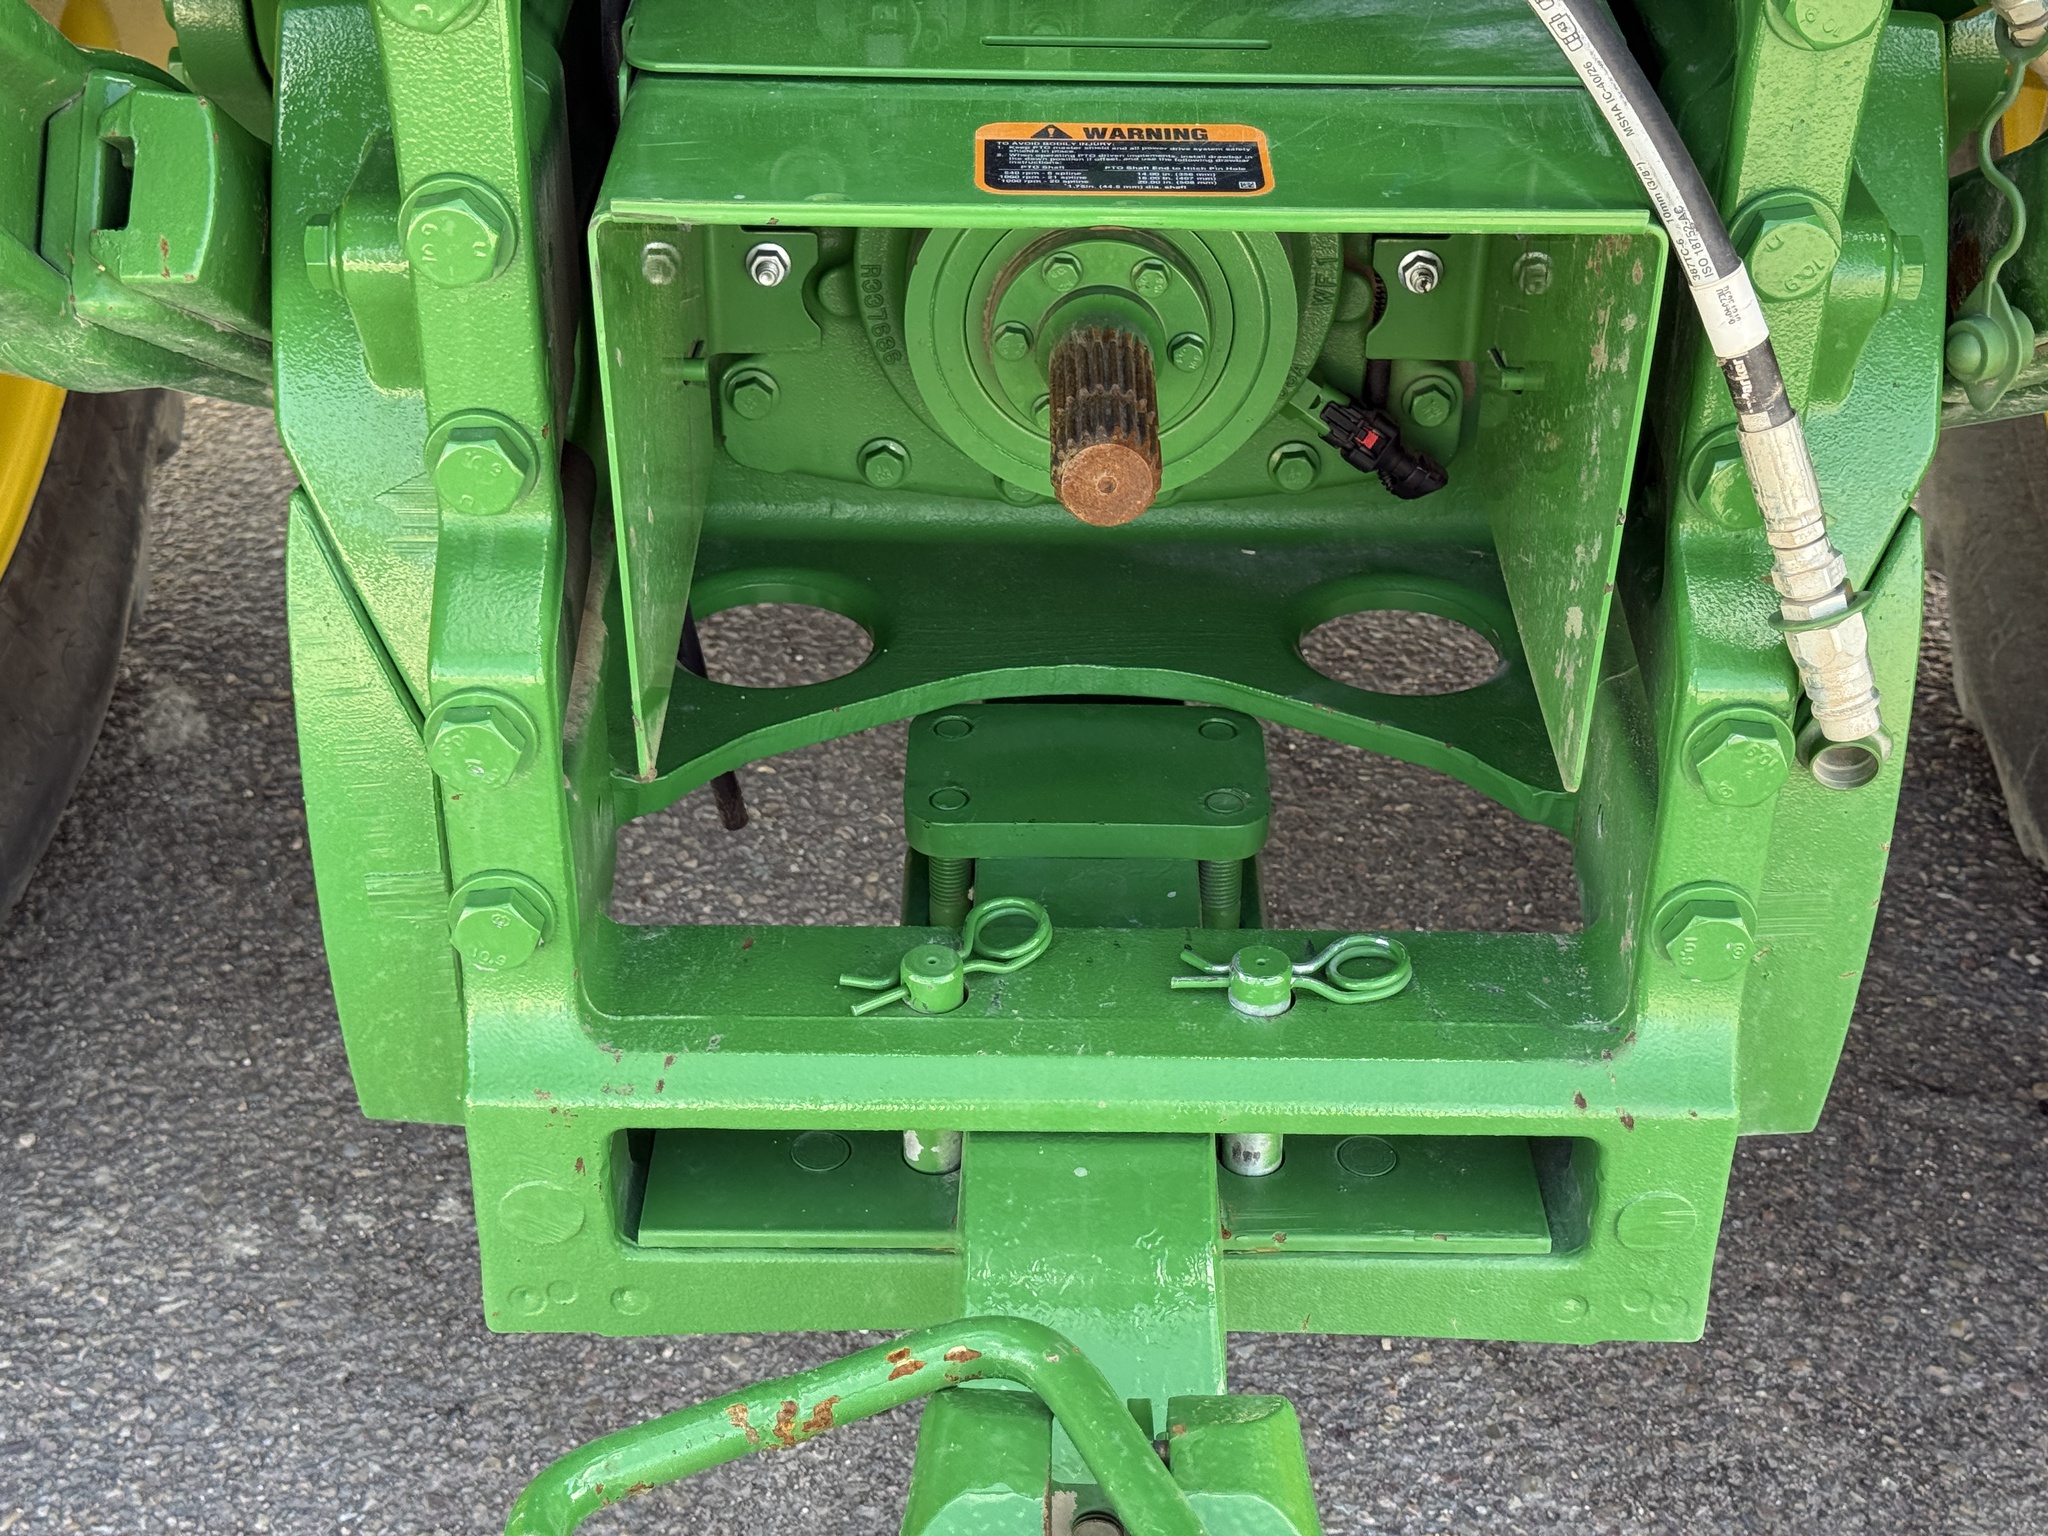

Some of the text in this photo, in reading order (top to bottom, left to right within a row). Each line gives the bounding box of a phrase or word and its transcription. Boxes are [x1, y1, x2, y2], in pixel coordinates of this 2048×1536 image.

[1583, 61, 1615, 104] IC-40/26
[1083, 127, 1208, 140] WARNING
[1611, 104, 1635, 137] MSHA
[1655, 192, 1674, 225] 10mm
[1674, 206, 1714, 278] ISO 18752-AC
[1676, 238, 1700, 281] 387TC-6
[860, 264, 902, 366] R337686
